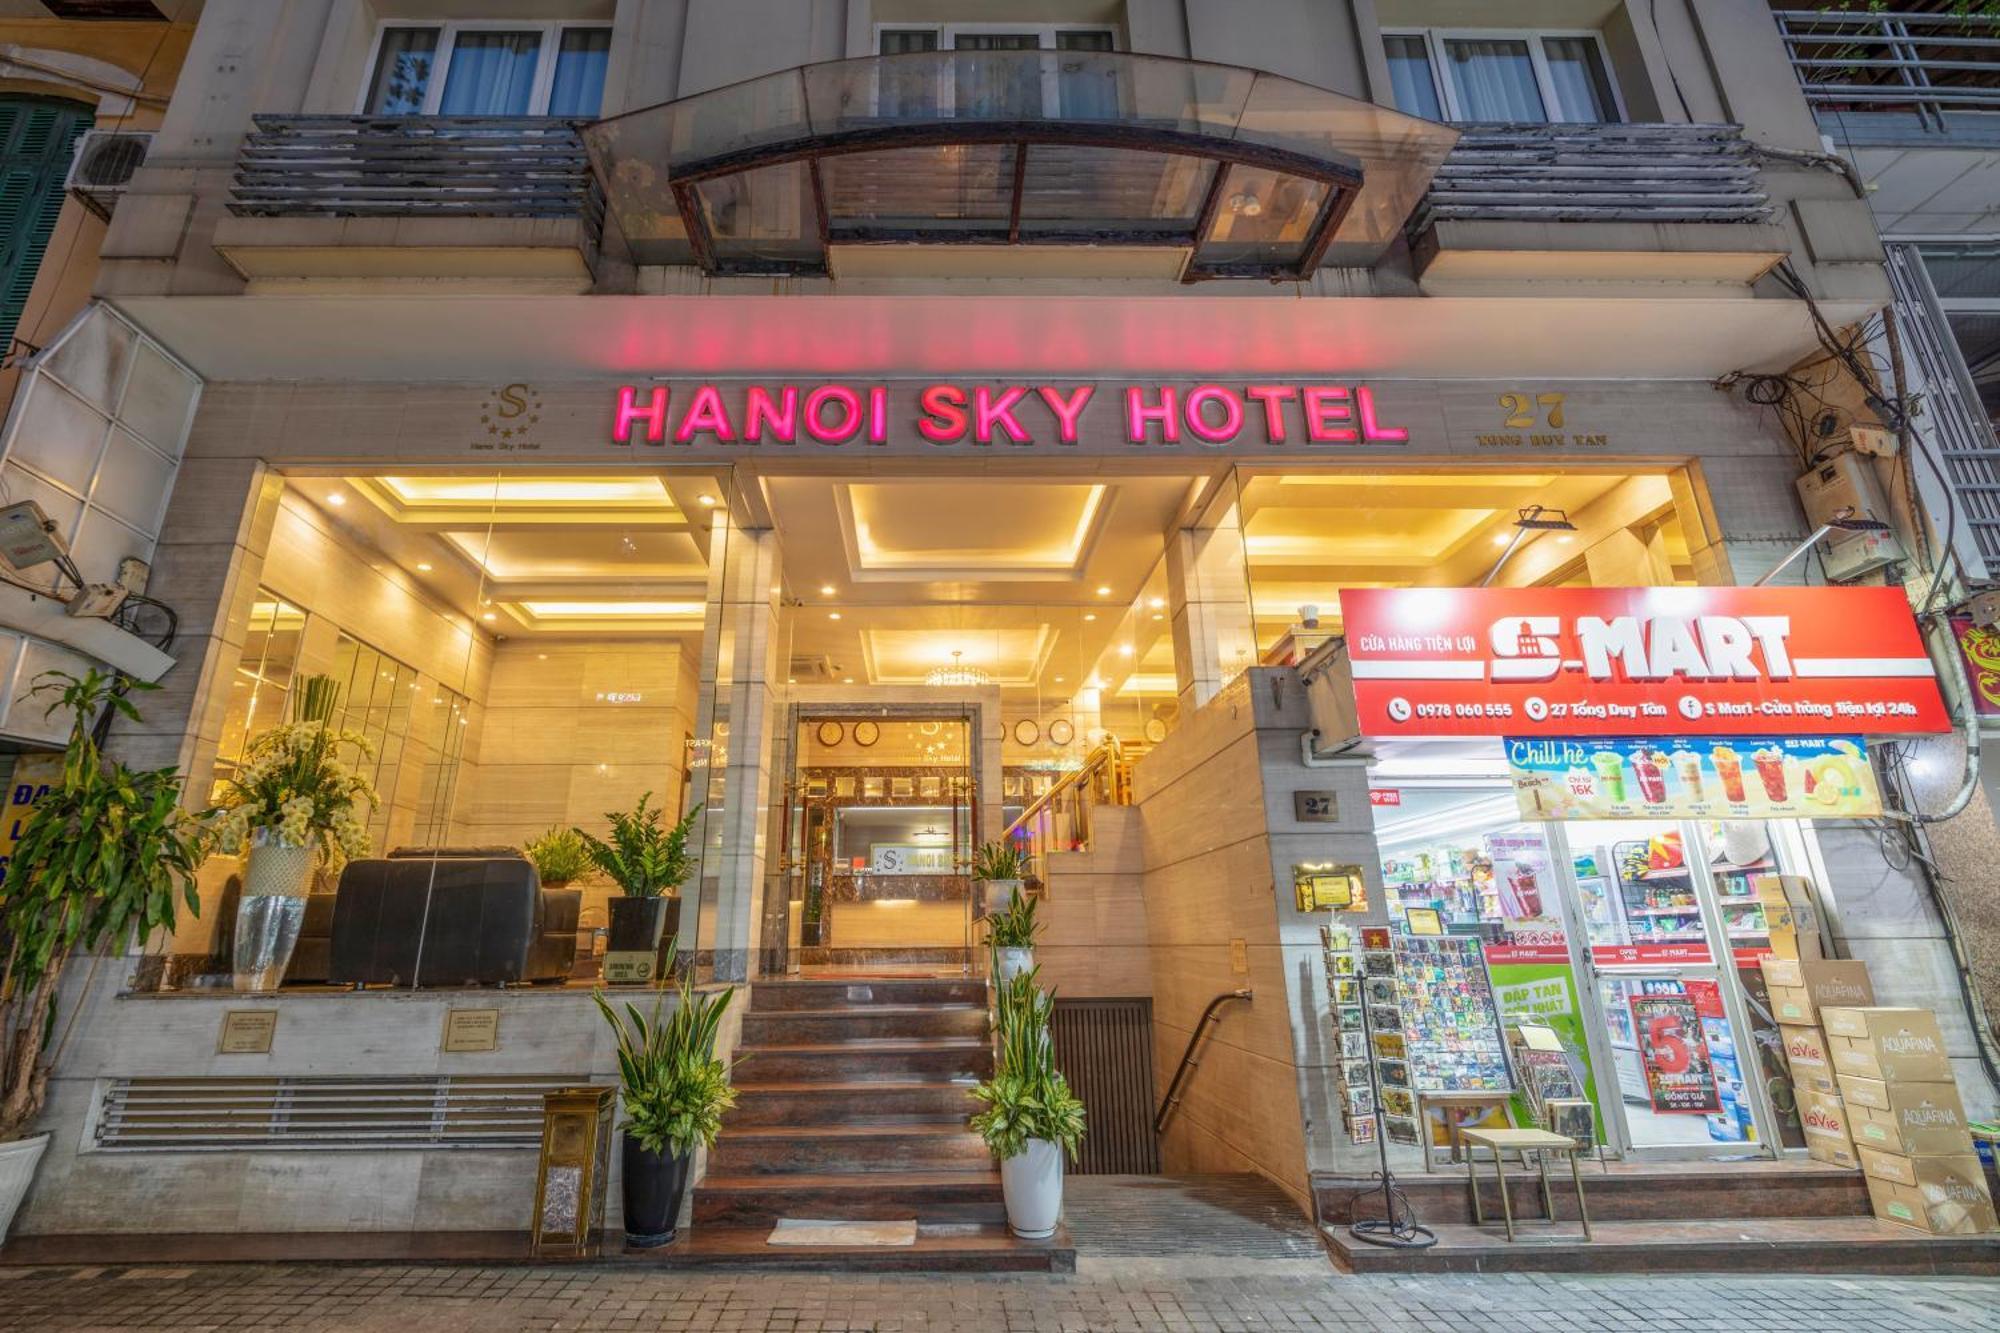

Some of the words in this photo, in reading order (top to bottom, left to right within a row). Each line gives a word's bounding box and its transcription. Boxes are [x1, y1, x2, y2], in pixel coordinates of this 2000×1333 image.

[498, 383, 528, 418] S
[1499, 390, 1568, 429] 27
[611, 383, 888, 446] HANOI
[917, 383, 1096, 446] SKY
[1126, 383, 1408, 446] HOTEL
[1490, 616, 1793, 684] S-MART
[1416, 702, 1451, 718] 0978
[1455, 702, 1483, 718] 060
[1485, 703, 1513, 718] 555
[1551, 703, 1567, 716] 27
[1571, 699, 1607, 719] Tống
[1608, 703, 1636, 719] Duy
[1887, 702, 1917, 716] 24h
[1511, 741, 1560, 766] Chill
[1563, 741, 1589, 767] hè
[1570, 785, 1594, 796] 16K
[1306, 798, 1329, 815] 27
[1650, 1016, 1690, 1073] 5
[1881, 1036, 1938, 1053] AQUAFINA
[1904, 1109, 1959, 1127] AQUAFINA
